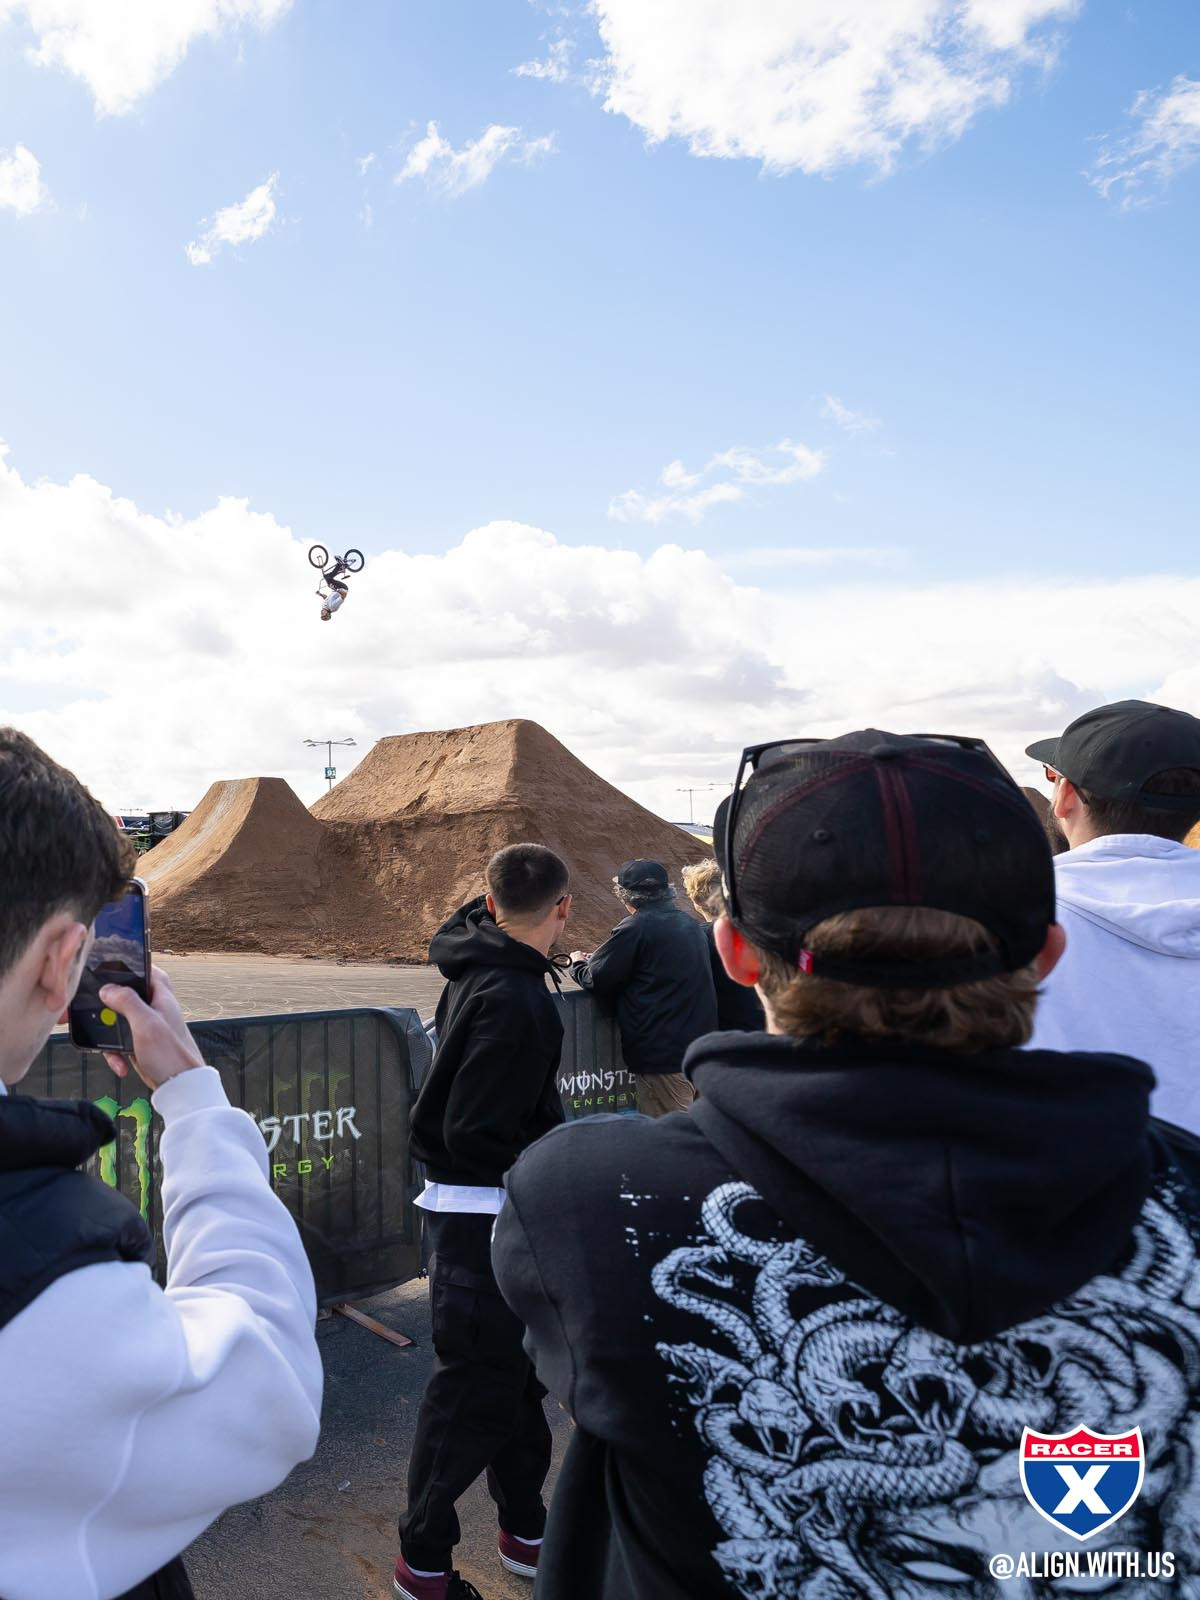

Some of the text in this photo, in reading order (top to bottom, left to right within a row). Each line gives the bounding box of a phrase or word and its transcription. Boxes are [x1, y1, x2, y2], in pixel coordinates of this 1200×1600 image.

[559, 1067, 637, 1097] MONSTE
[256, 1105, 362, 1155] STER
[272, 1154, 335, 1179] RGY
